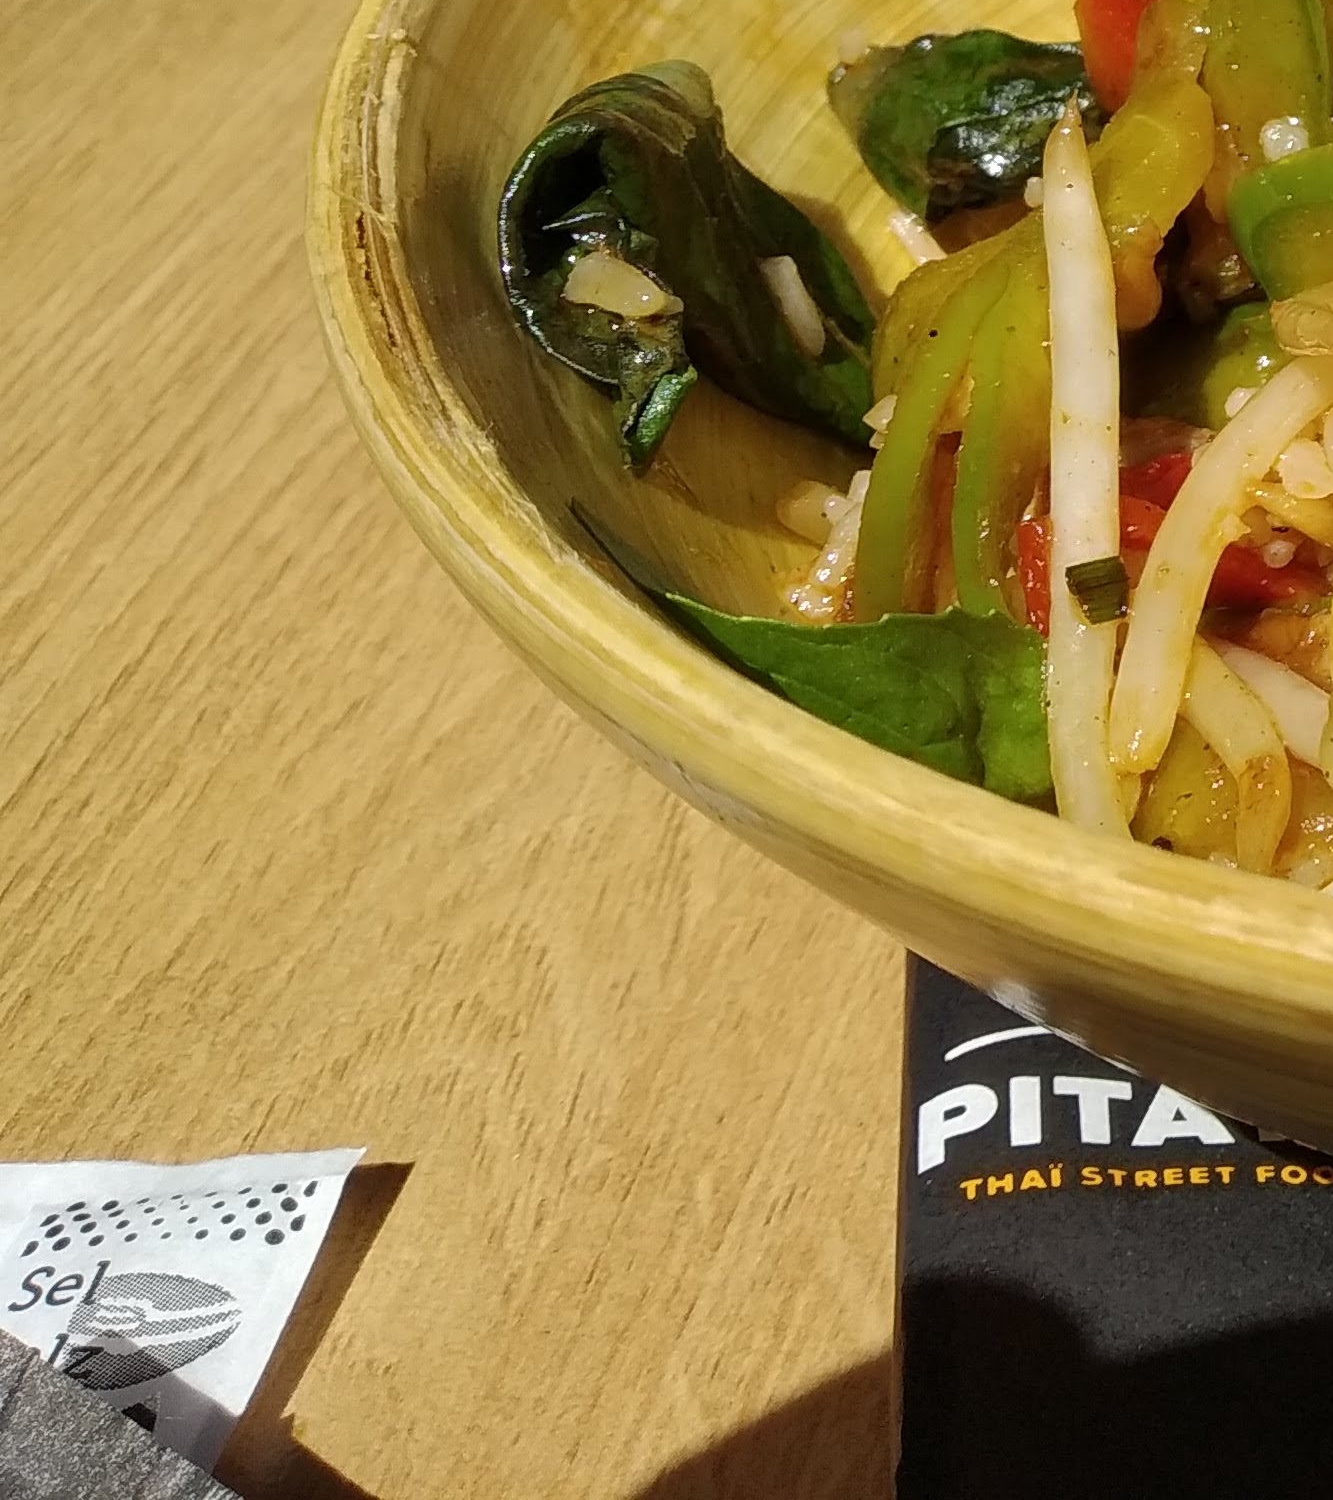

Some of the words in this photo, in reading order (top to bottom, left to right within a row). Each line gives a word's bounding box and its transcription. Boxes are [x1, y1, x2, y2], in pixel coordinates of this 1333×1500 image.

[917, 1075, 1287, 1176] PITA
[959, 1162, 1063, 1201] THAÏ
[1080, 1165, 1235, 1189] STREET
[8, 1260, 111, 1312] Sel
